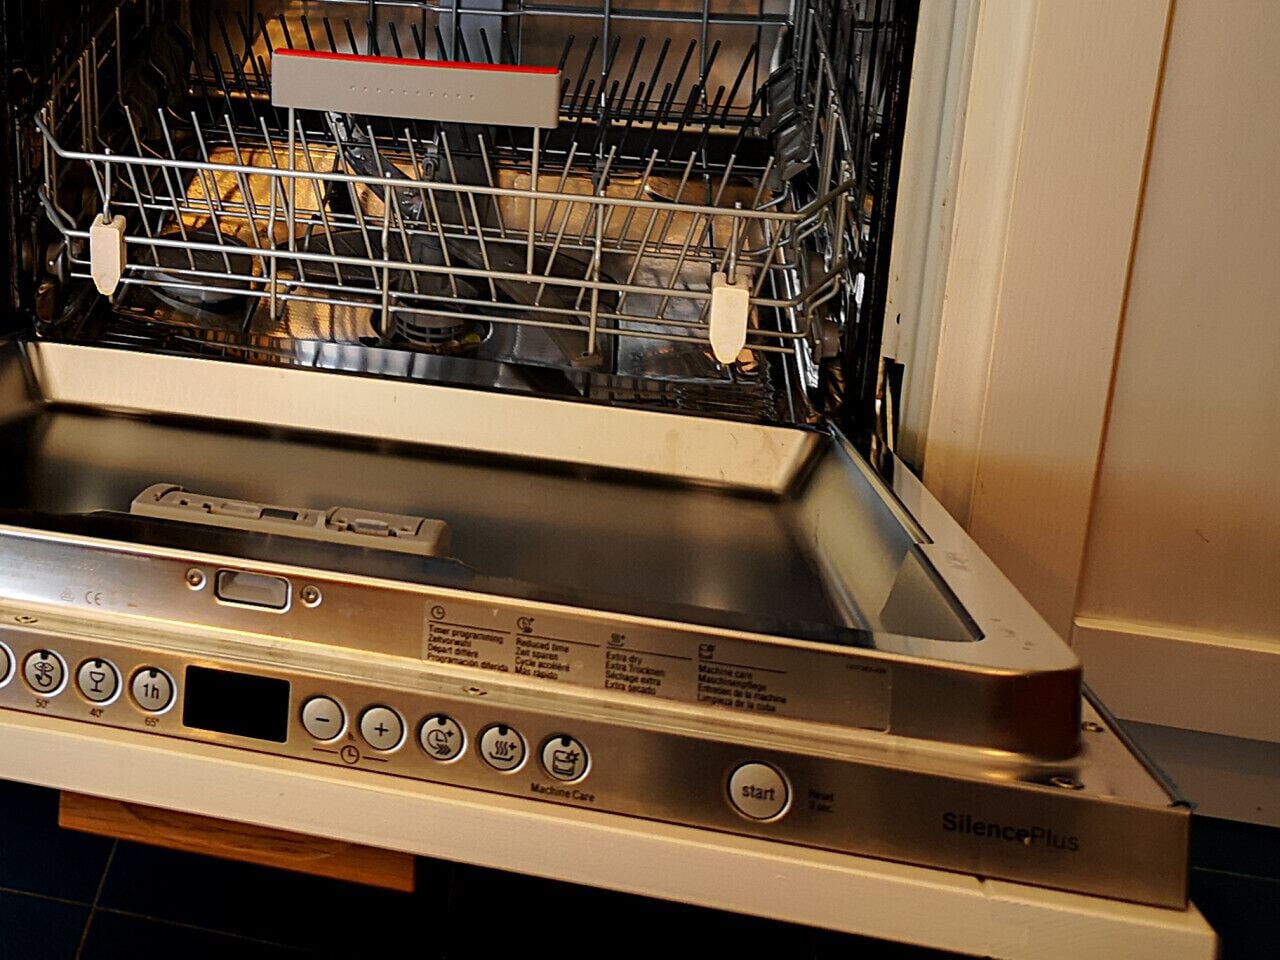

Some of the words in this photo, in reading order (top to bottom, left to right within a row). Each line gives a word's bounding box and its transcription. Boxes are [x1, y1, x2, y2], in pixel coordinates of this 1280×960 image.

[428, 624, 450, 635] Timer
[452, 629, 504, 645] programming
[606, 651, 627, 662] Extra
[629, 655, 643, 665] dry
[606, 660, 627, 671] Extra
[143, 683, 159, 700] 1h
[605, 680, 626, 690] Extra
[531, 782, 571, 799] Machine
[572, 789, 595, 802] Care
[742, 784, 775, 801] start
[942, 811, 1080, 852] SilencePlus
